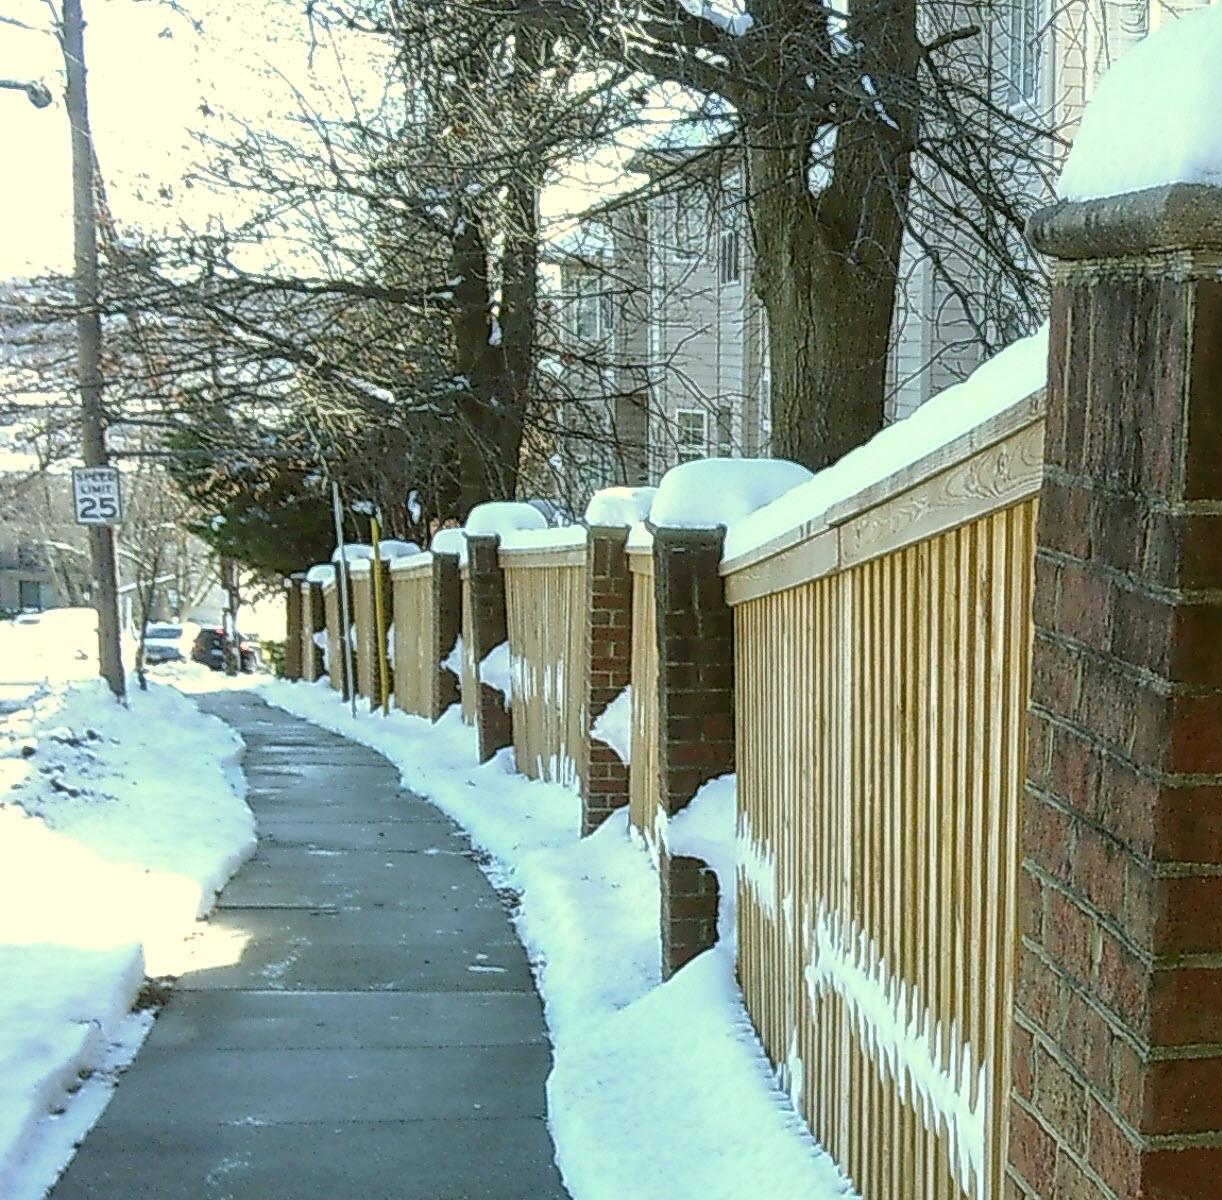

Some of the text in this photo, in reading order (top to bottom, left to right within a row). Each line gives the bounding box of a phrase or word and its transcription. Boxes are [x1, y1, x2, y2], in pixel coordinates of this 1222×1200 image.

[76, 472, 115, 482] SPEED
[81, 485, 111, 495] LIMIT
[79, 497, 117, 519] 25
